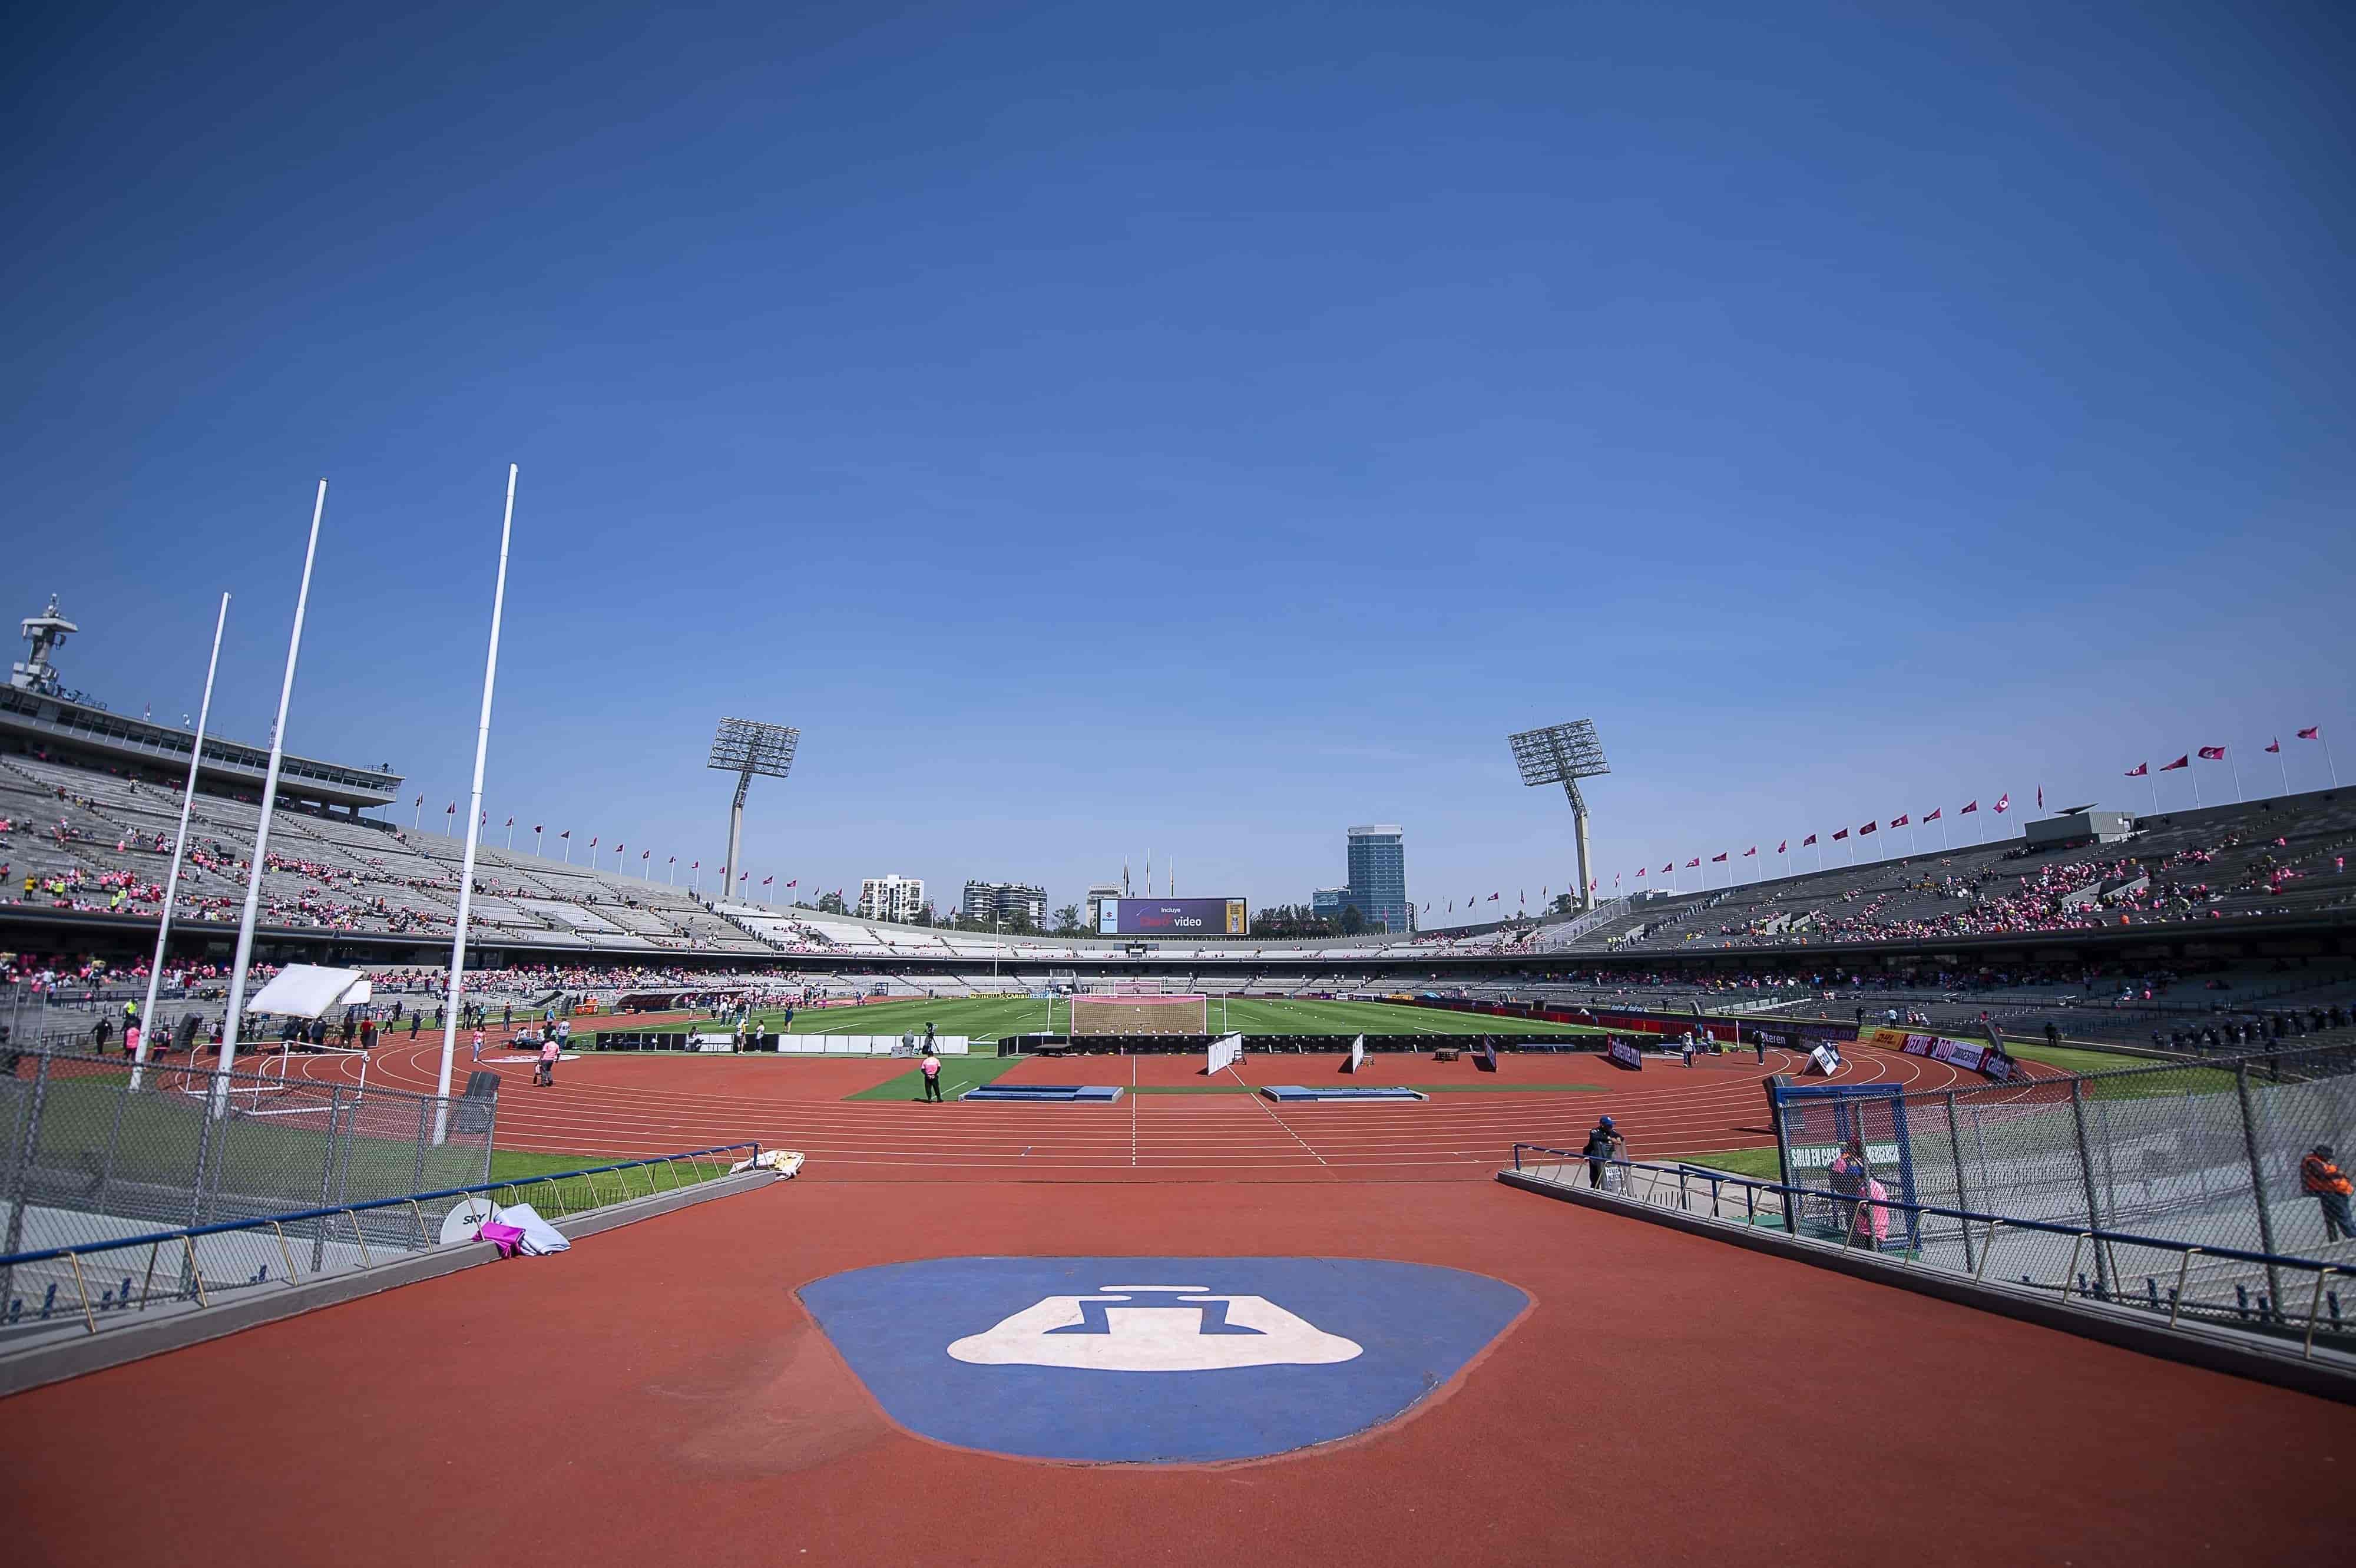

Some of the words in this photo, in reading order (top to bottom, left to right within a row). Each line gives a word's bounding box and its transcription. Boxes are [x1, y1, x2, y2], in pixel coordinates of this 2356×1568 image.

[1174, 916, 1202, 927] video
[1612, 1037, 1640, 1066] caliente.mx
[463, 1213, 486, 1225] SKY
